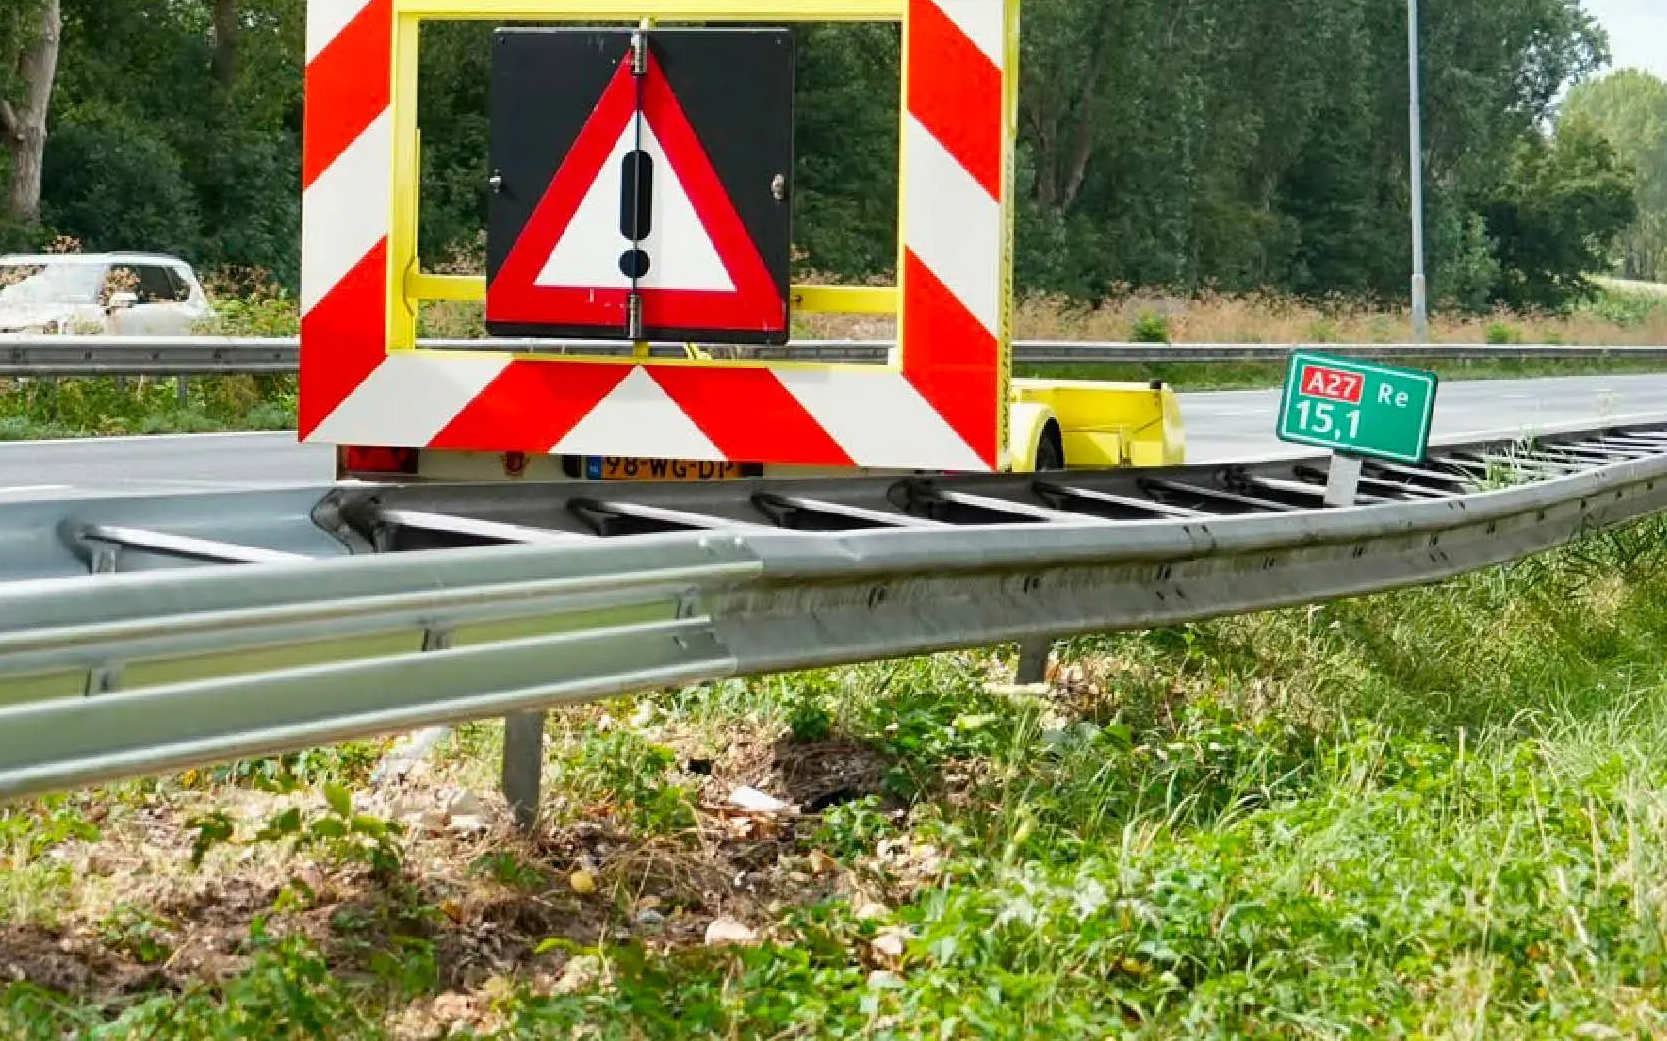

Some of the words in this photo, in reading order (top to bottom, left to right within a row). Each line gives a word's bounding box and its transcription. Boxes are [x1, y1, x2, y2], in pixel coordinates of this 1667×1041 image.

[1307, 370, 1357, 399] A27
[1377, 382, 1410, 407] Re
[1296, 399, 1361, 441] 15,1
